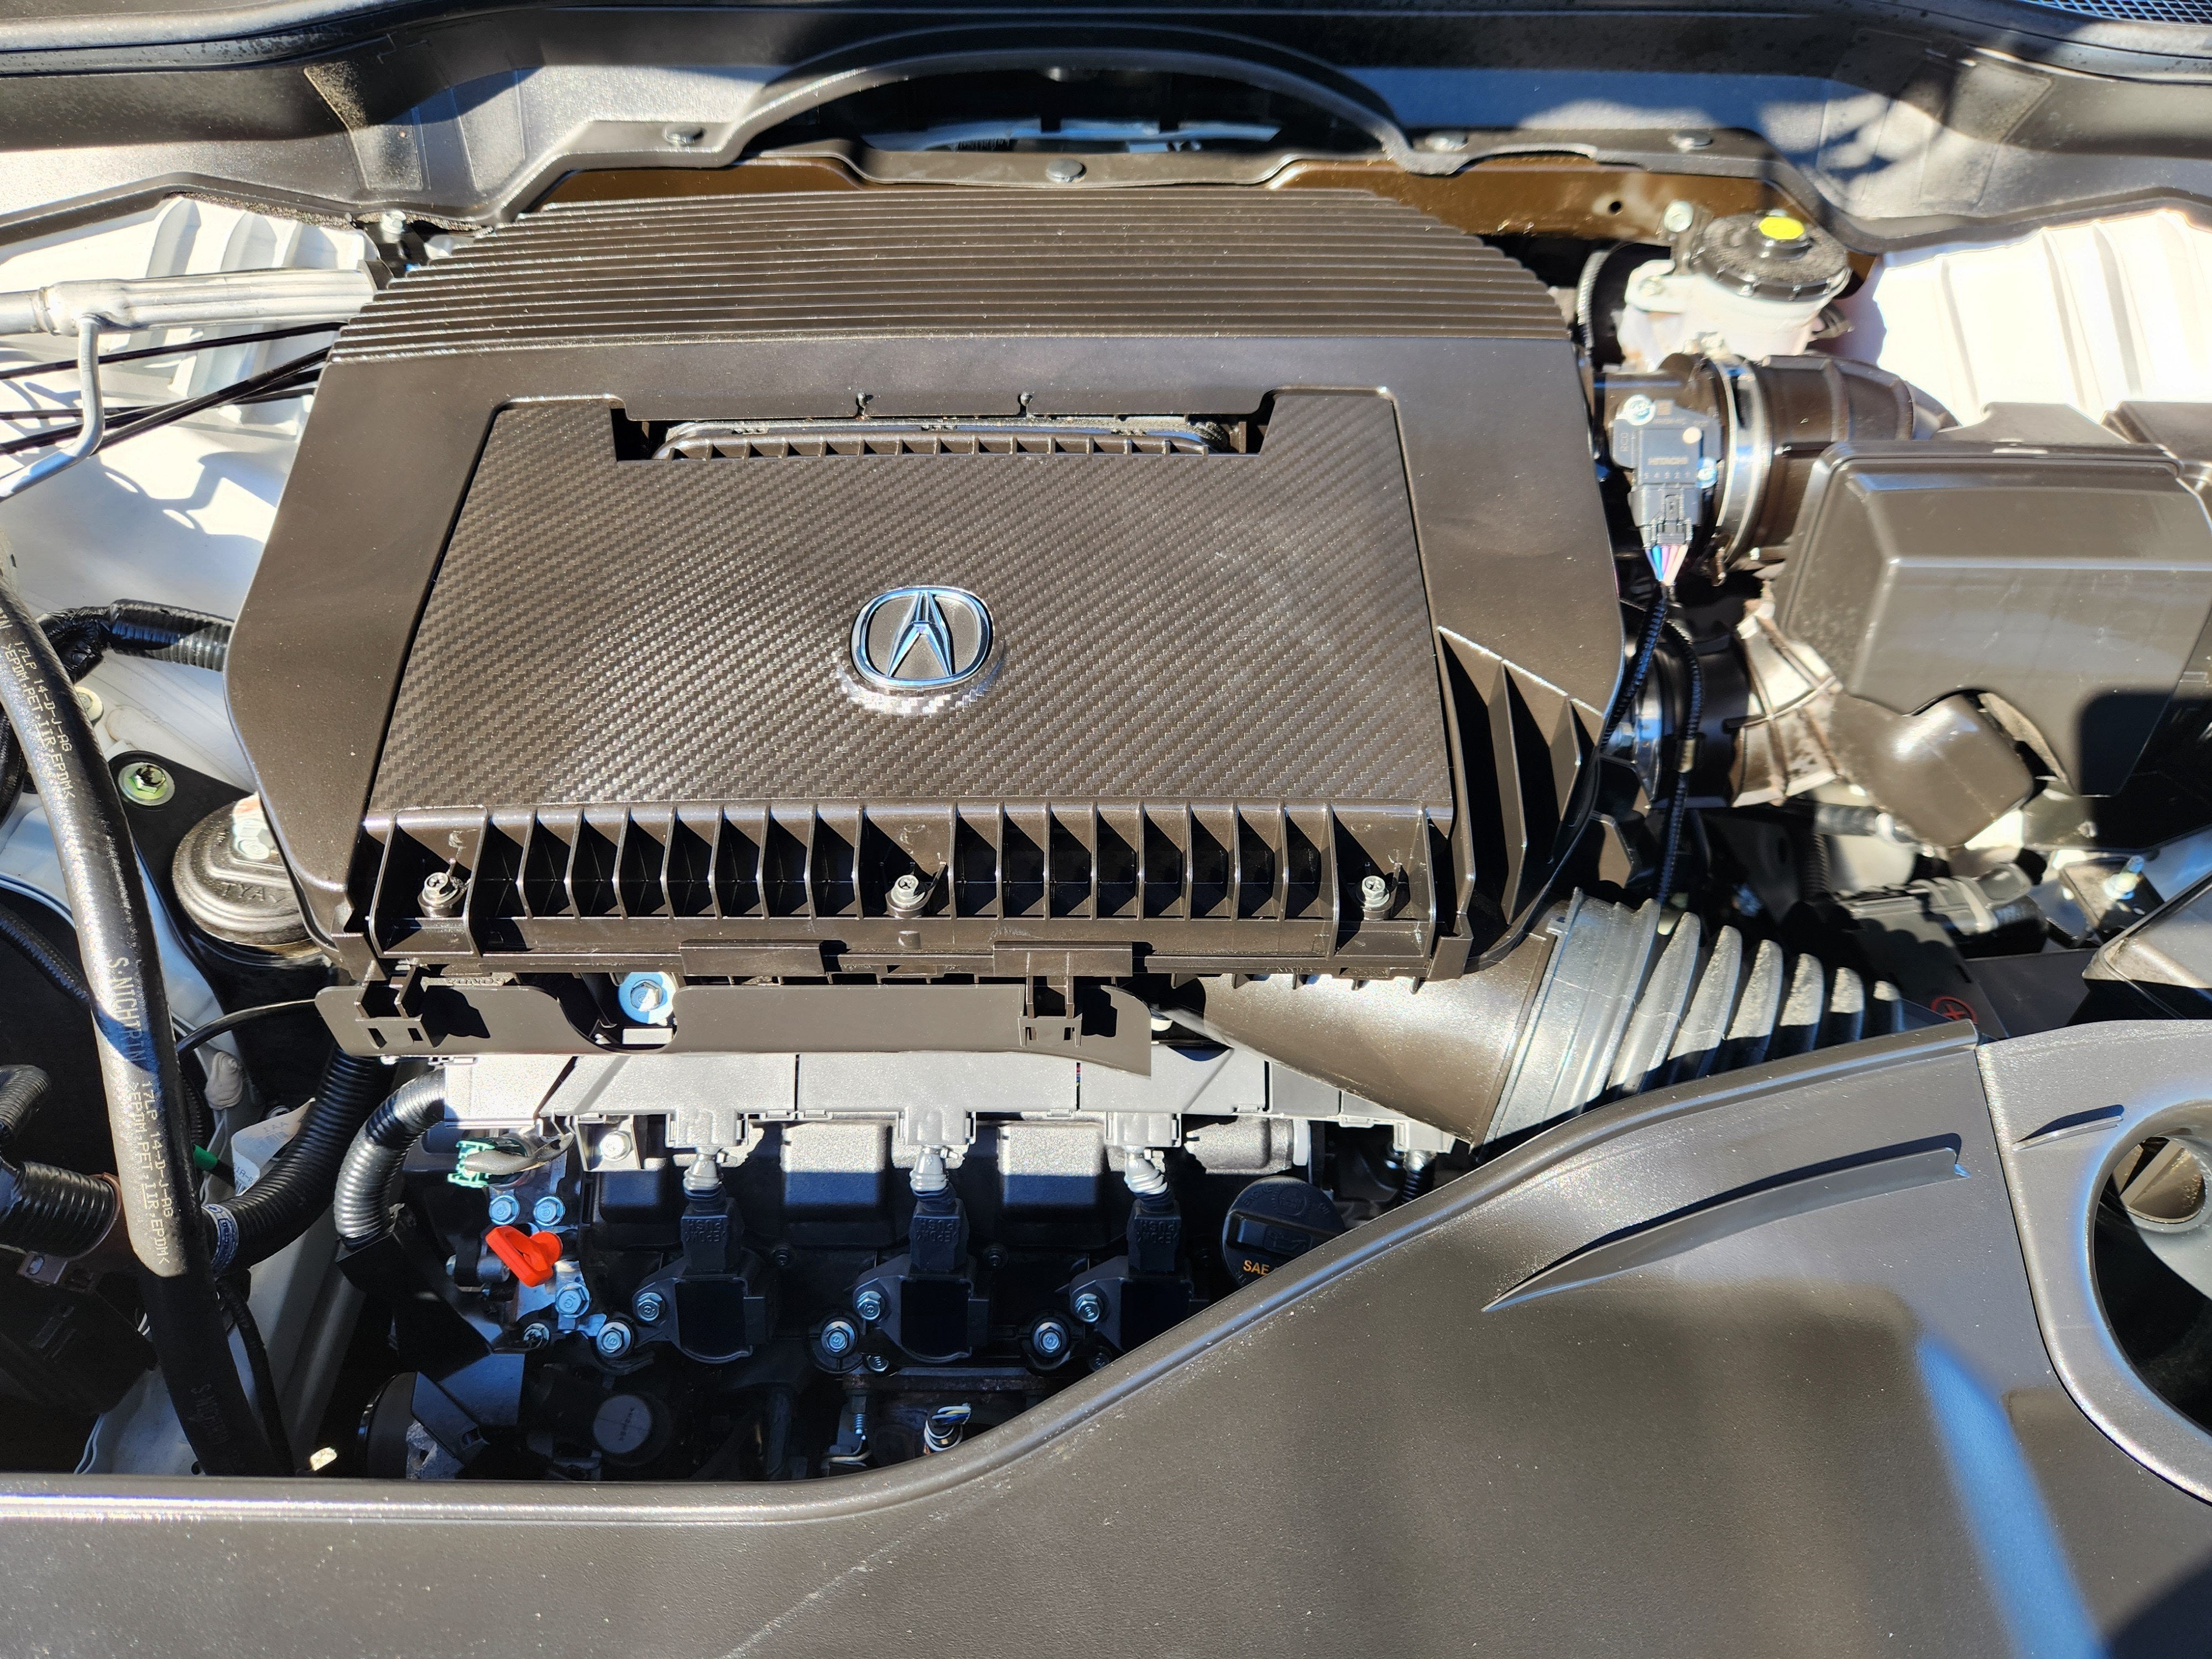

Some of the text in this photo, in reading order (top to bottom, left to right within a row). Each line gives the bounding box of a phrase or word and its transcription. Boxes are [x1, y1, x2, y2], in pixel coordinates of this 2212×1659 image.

[14, 640, 72, 752] 17LP 14-D-J-AG
[150, 1133, 174, 1218] 14-D-J-AG
[1243, 1259, 1271, 1276] SAE
